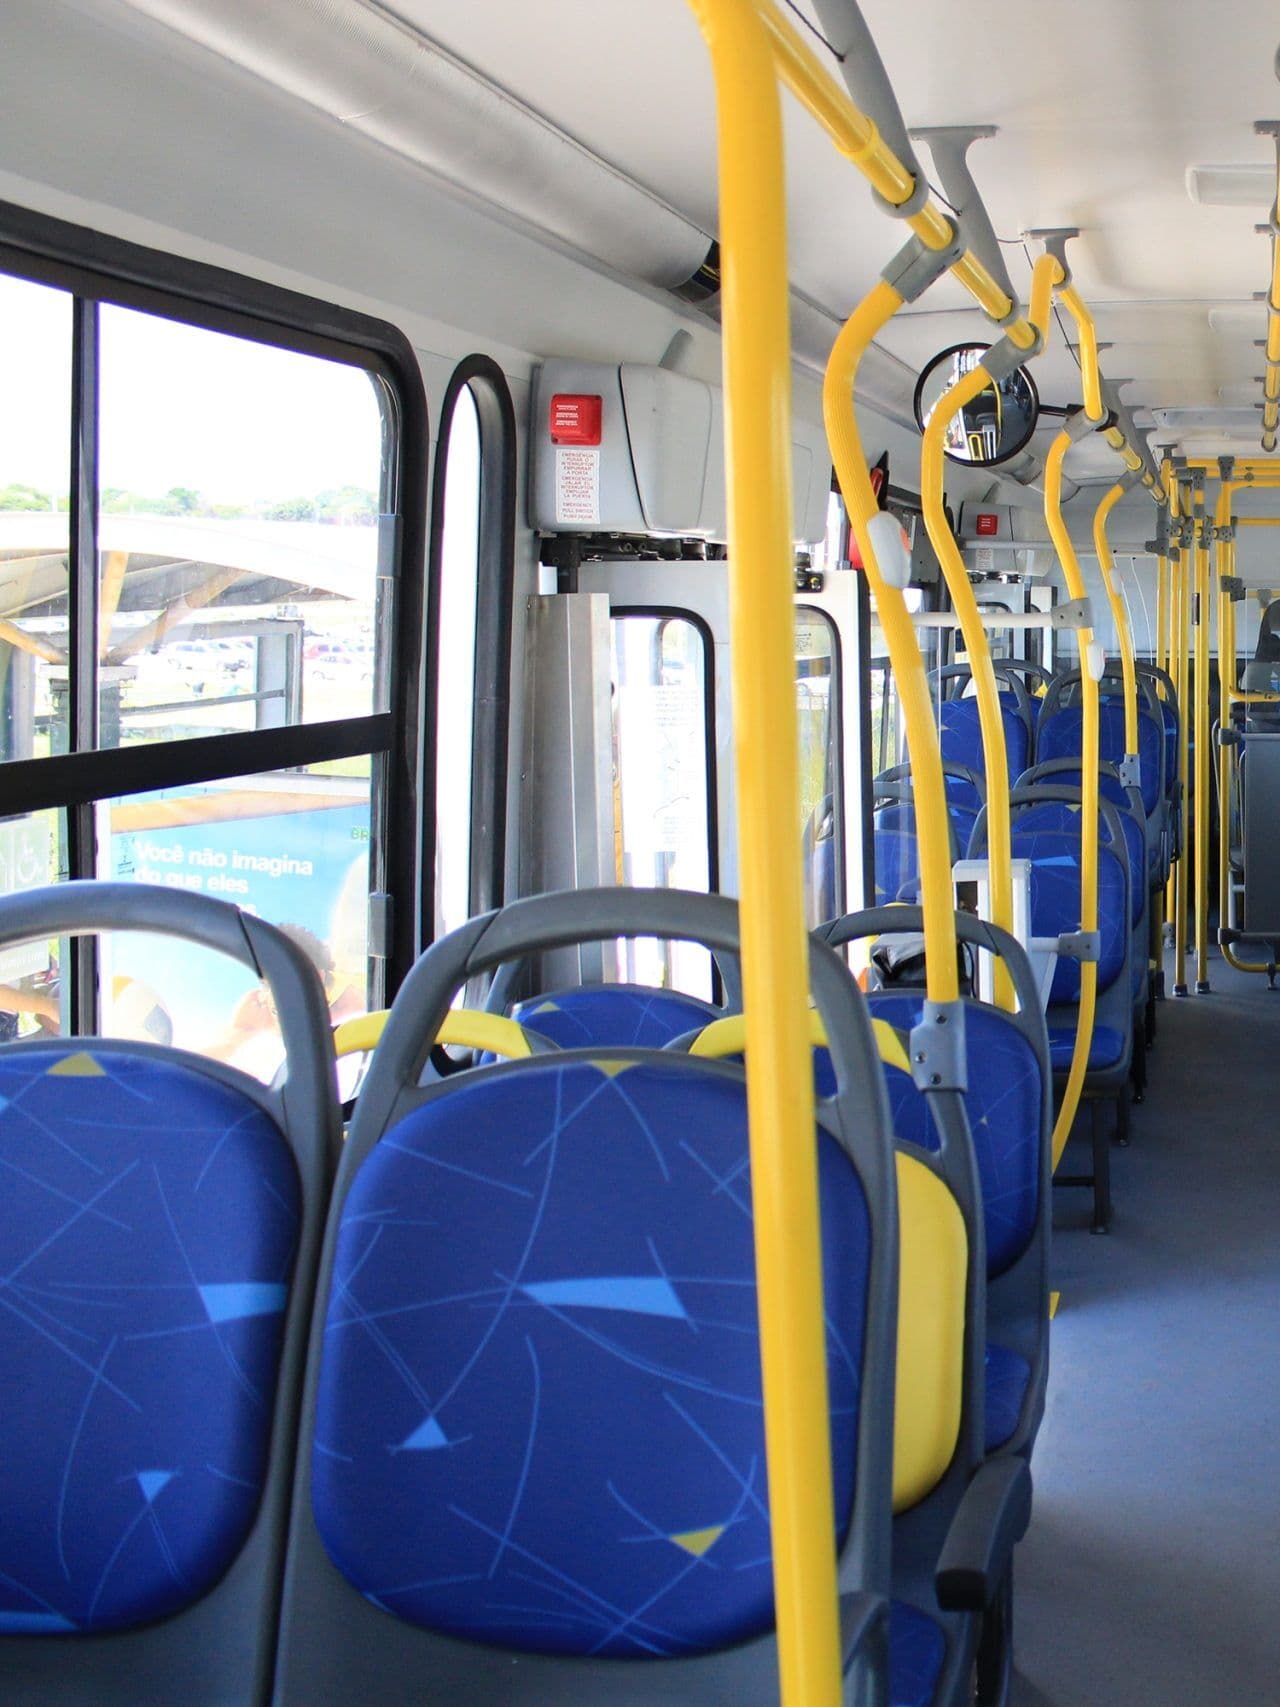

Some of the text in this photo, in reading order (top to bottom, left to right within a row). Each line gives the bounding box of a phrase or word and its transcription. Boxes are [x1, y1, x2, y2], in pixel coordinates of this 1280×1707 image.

[134, 841, 184, 864] Você
[188, 847, 228, 868] não
[232, 850, 314, 877] imagina
[134, 865, 162, 884] do
[206, 873, 249, 894] eles
